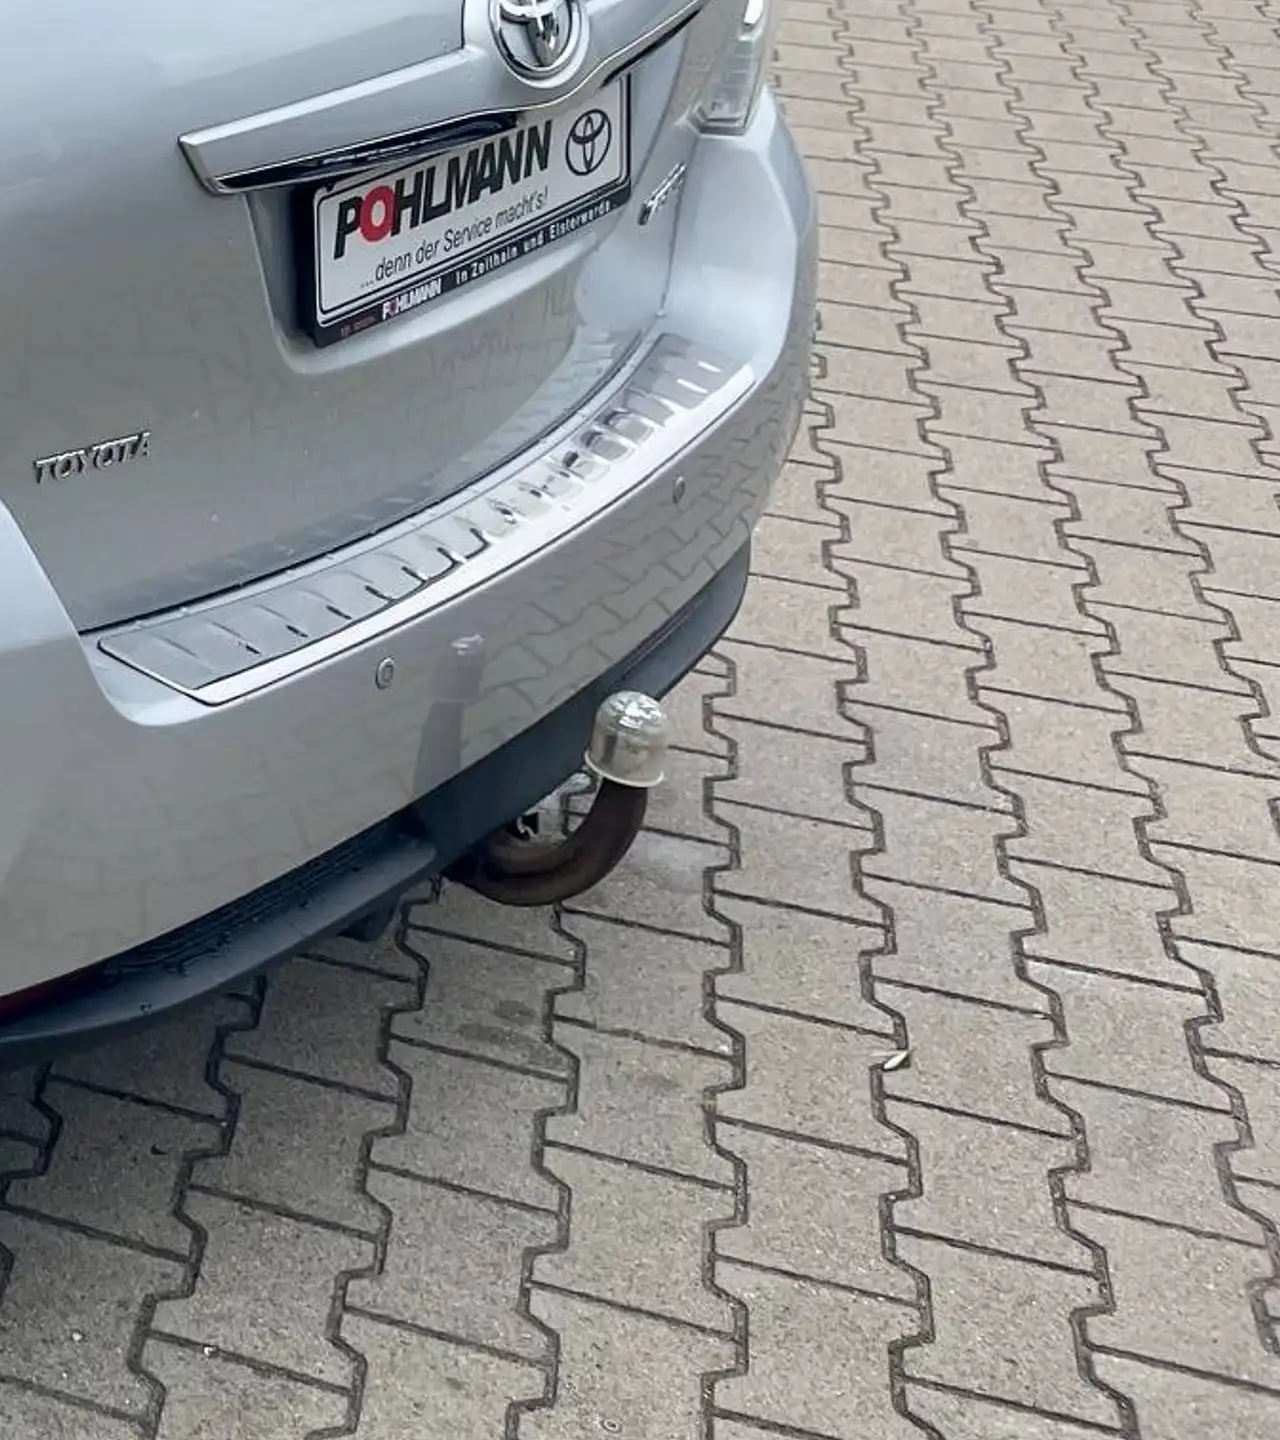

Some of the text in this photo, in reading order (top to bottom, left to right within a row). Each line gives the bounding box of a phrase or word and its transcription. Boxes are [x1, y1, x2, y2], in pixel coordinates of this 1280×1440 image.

[334, 119, 552, 260] POHLMANN
[415, 239, 440, 264] der
[444, 216, 493, 252] Service
[382, 277, 442, 321] POHLMANN
[32, 429, 151, 484] TOYOTA
